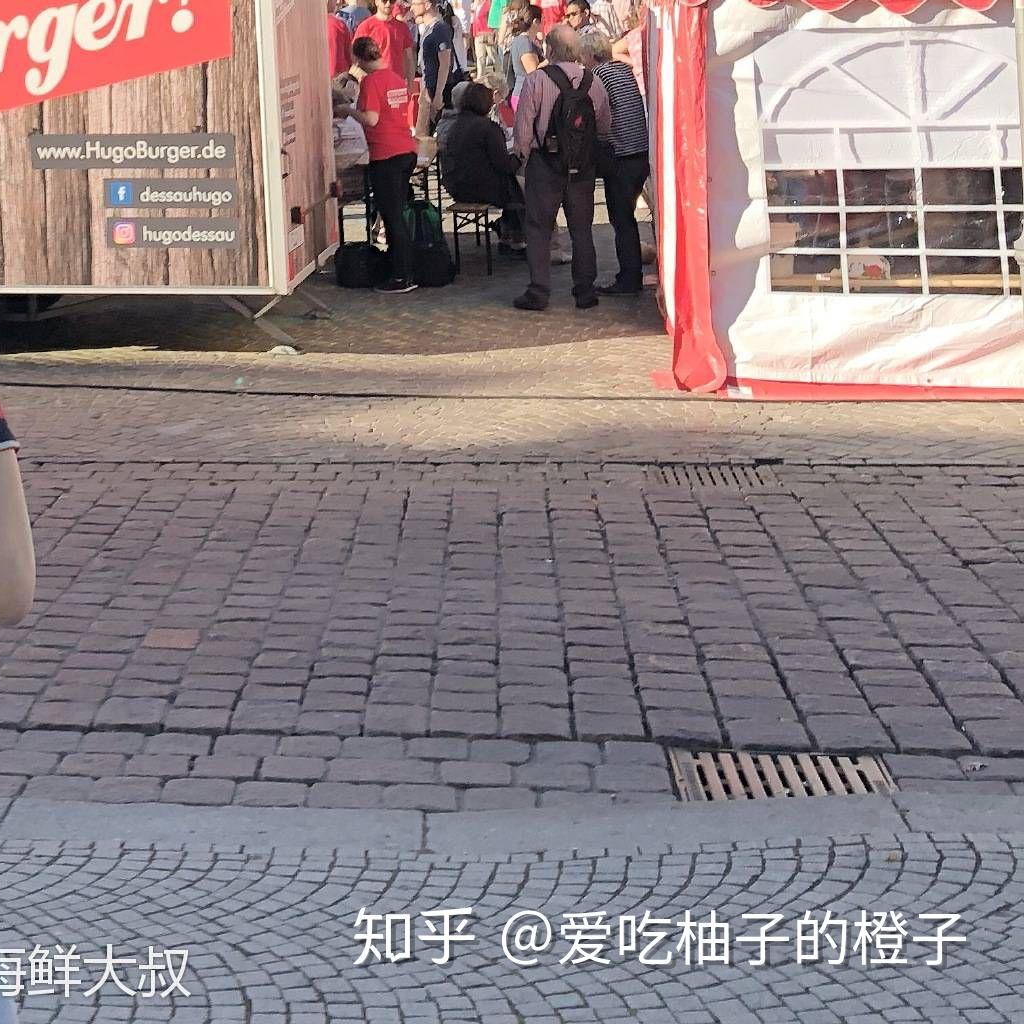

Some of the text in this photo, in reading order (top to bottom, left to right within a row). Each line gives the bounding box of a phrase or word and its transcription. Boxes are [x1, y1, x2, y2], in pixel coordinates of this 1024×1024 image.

[36, 139, 226, 164] www.HugoBurger.de
[139, 186, 233, 205] dessauhugo
[142, 226, 236, 245] hugodessau
